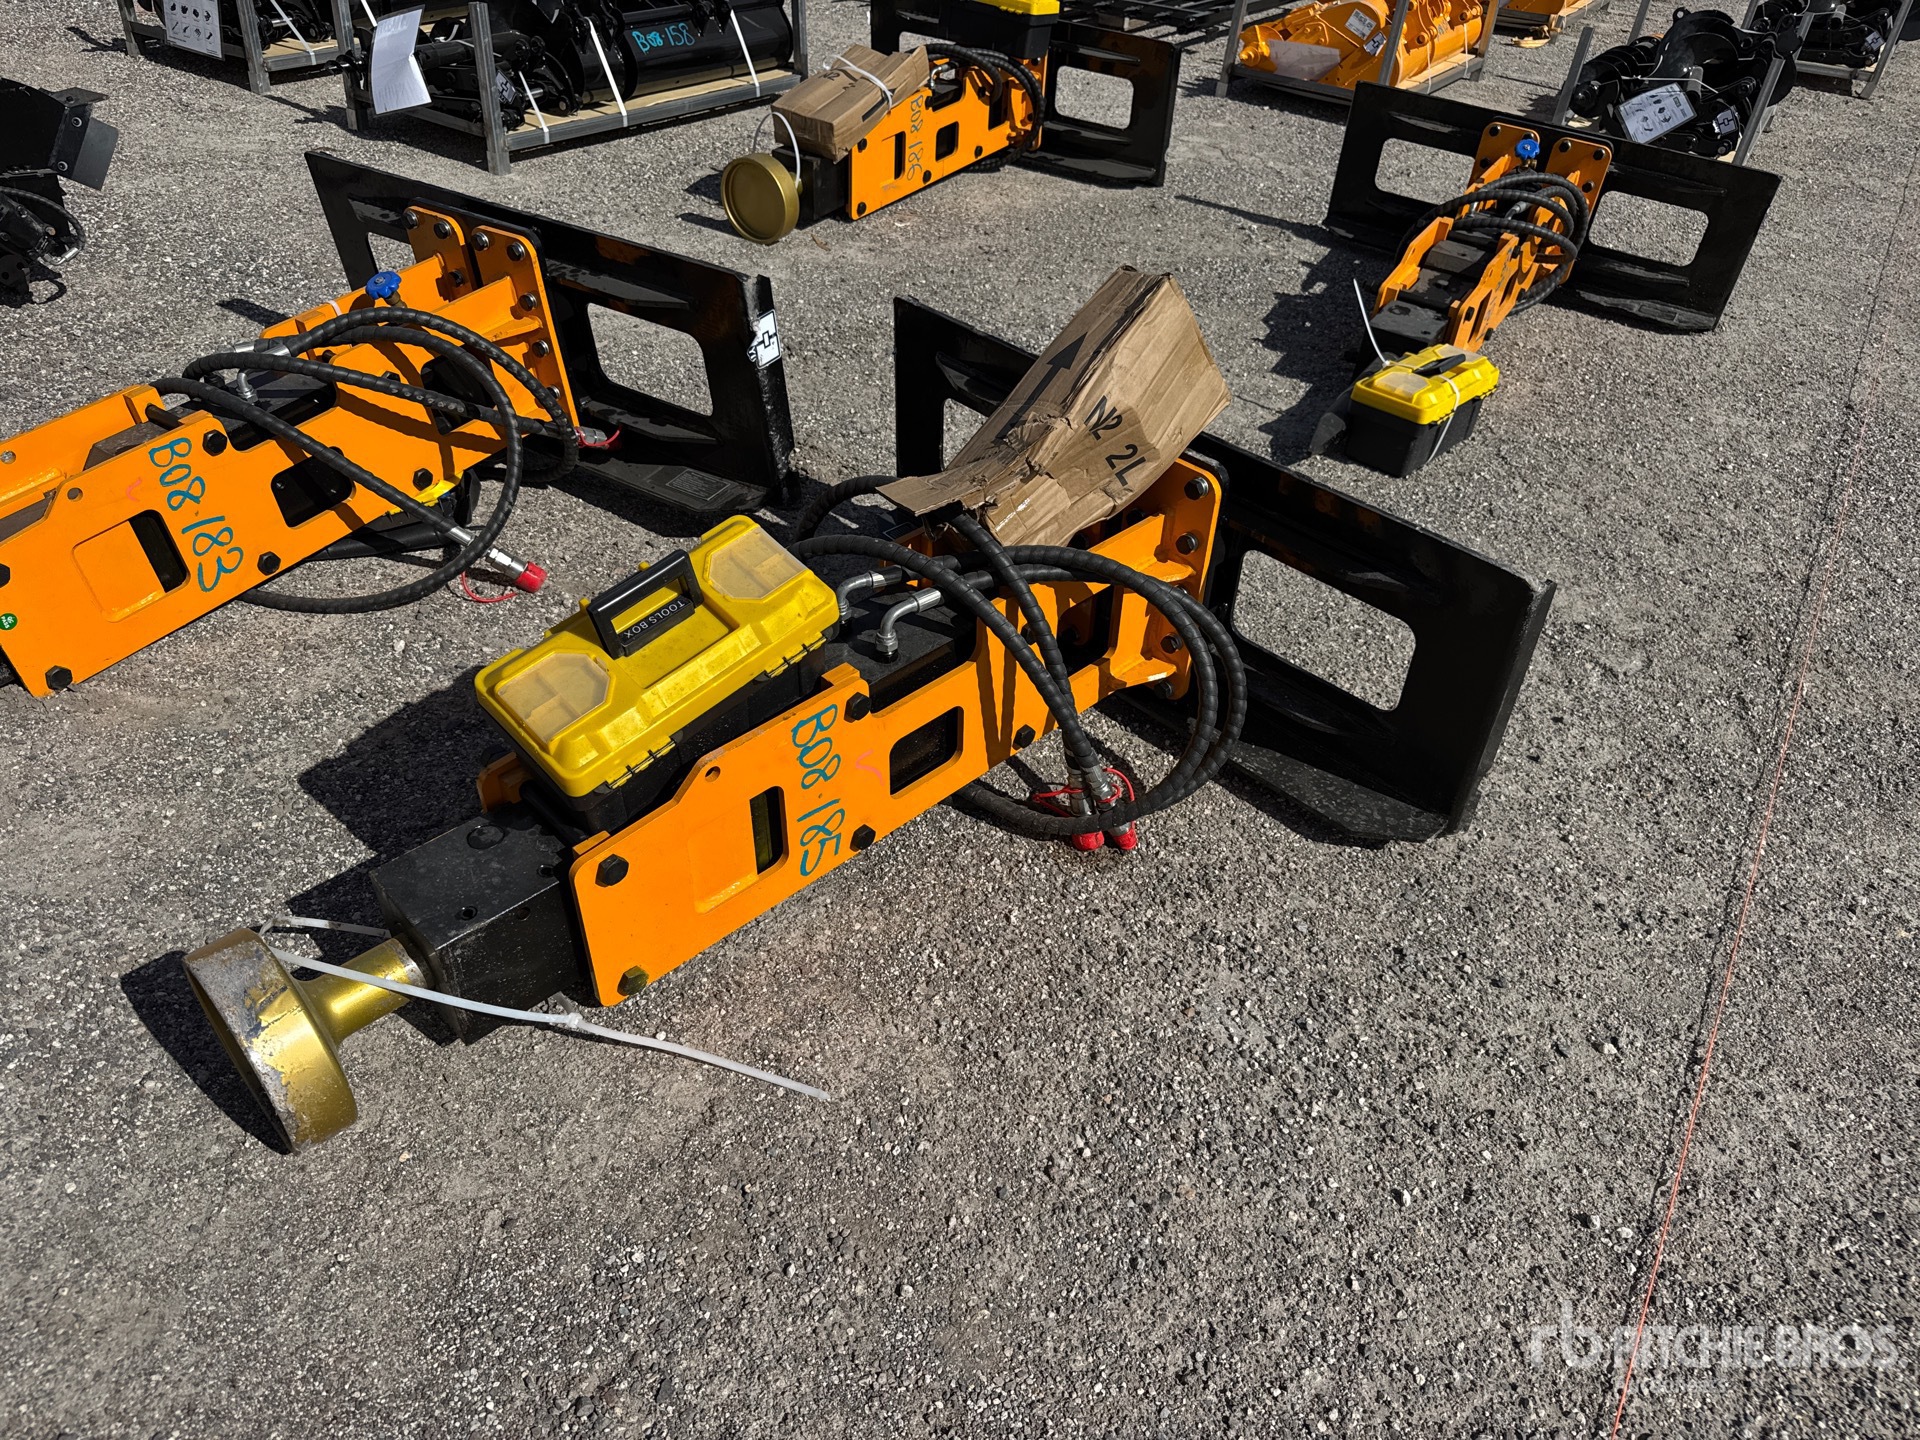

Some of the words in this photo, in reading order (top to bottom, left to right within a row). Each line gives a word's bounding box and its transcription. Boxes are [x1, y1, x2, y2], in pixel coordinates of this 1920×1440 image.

[648, 600, 686, 624] TOOLS
[1, 616, 10, 629] PASS
[624, 621, 649, 638] BOX
